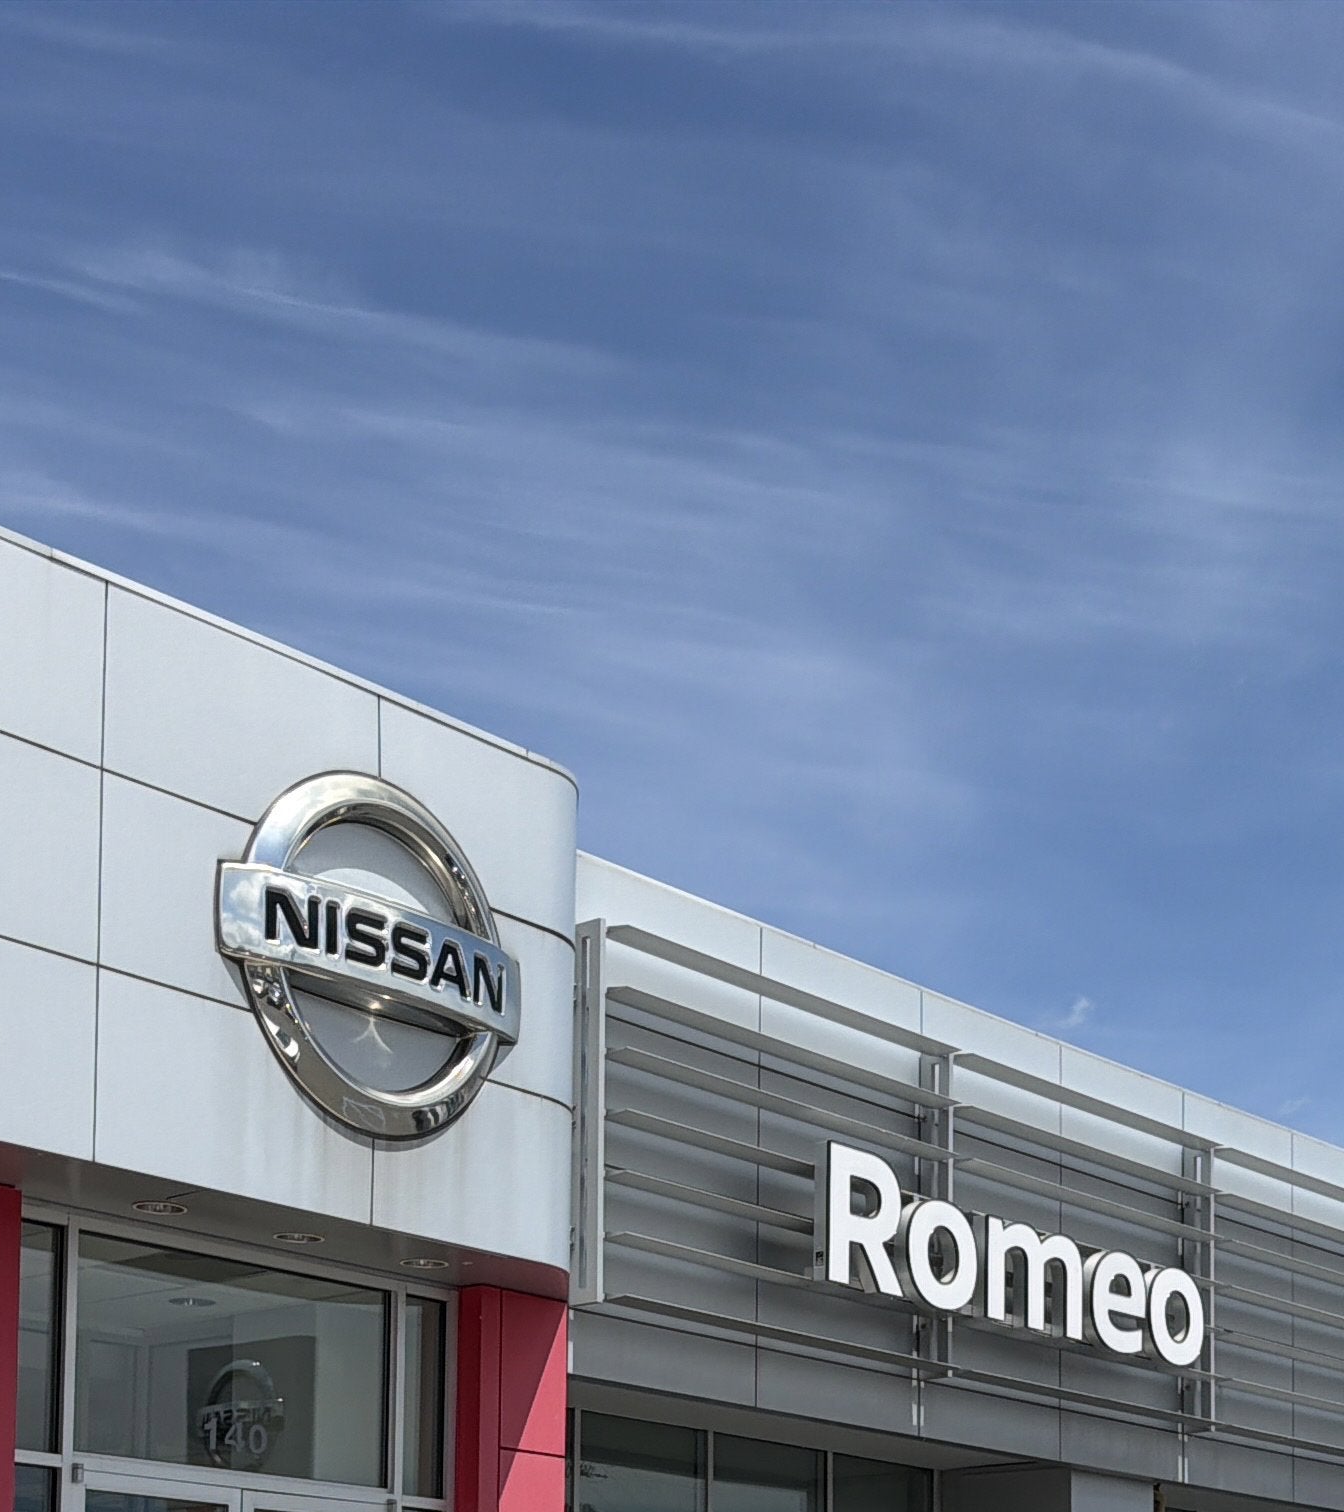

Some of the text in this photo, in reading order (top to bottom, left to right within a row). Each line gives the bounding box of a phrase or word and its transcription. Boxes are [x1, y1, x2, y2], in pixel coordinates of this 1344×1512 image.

[264, 885, 505, 1016] NISSAN
[823, 1139, 1204, 1367] Romeo
[203, 1417, 268, 1454] 140
